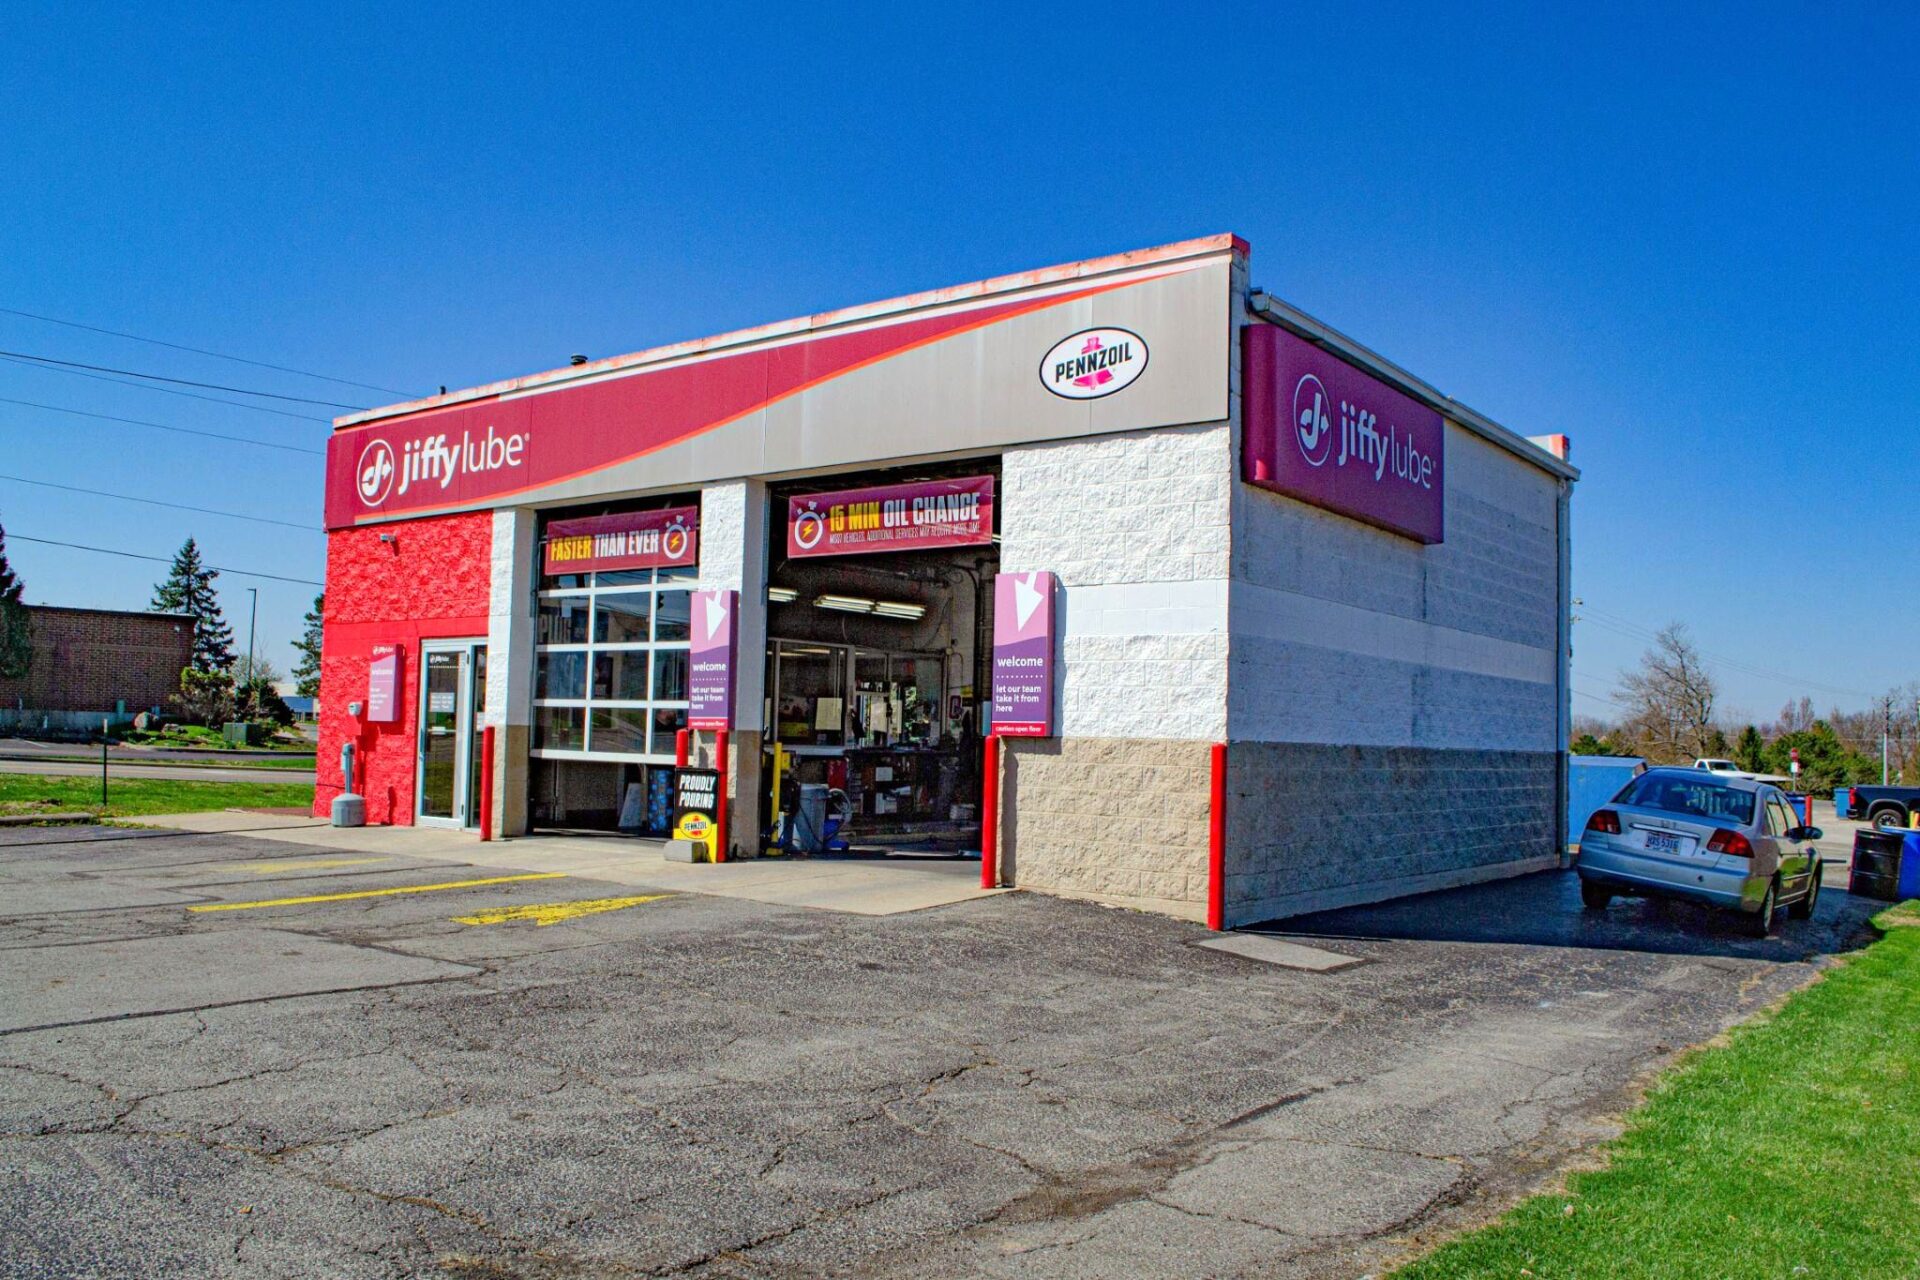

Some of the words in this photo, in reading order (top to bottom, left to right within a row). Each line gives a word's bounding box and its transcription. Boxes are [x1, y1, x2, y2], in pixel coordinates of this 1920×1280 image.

[1055, 342, 1133, 383] PENNZOIL
[830, 505, 844, 532] 15
[848, 501, 880, 531] MIN
[884, 500, 909, 528] OIL
[912, 492, 980, 526] CHANGE
[550, 535, 592, 561] FASTER
[595, 532, 626, 558] THAN
[628, 529, 659, 554] EVER
[693, 661, 726, 672] welcome
[997, 656, 1043, 667] welcome
[995, 684, 1006, 693] let
[1007, 685, 1020, 693] our
[1022, 685, 1042, 693] team
[996, 694, 1012, 702] take
[1013, 694, 1019, 702] it
[1021, 694, 1039, 702] from
[995, 703, 1013, 712] here
[679, 775, 716, 791] PROUDLY
[679, 791, 715, 809] POURING
